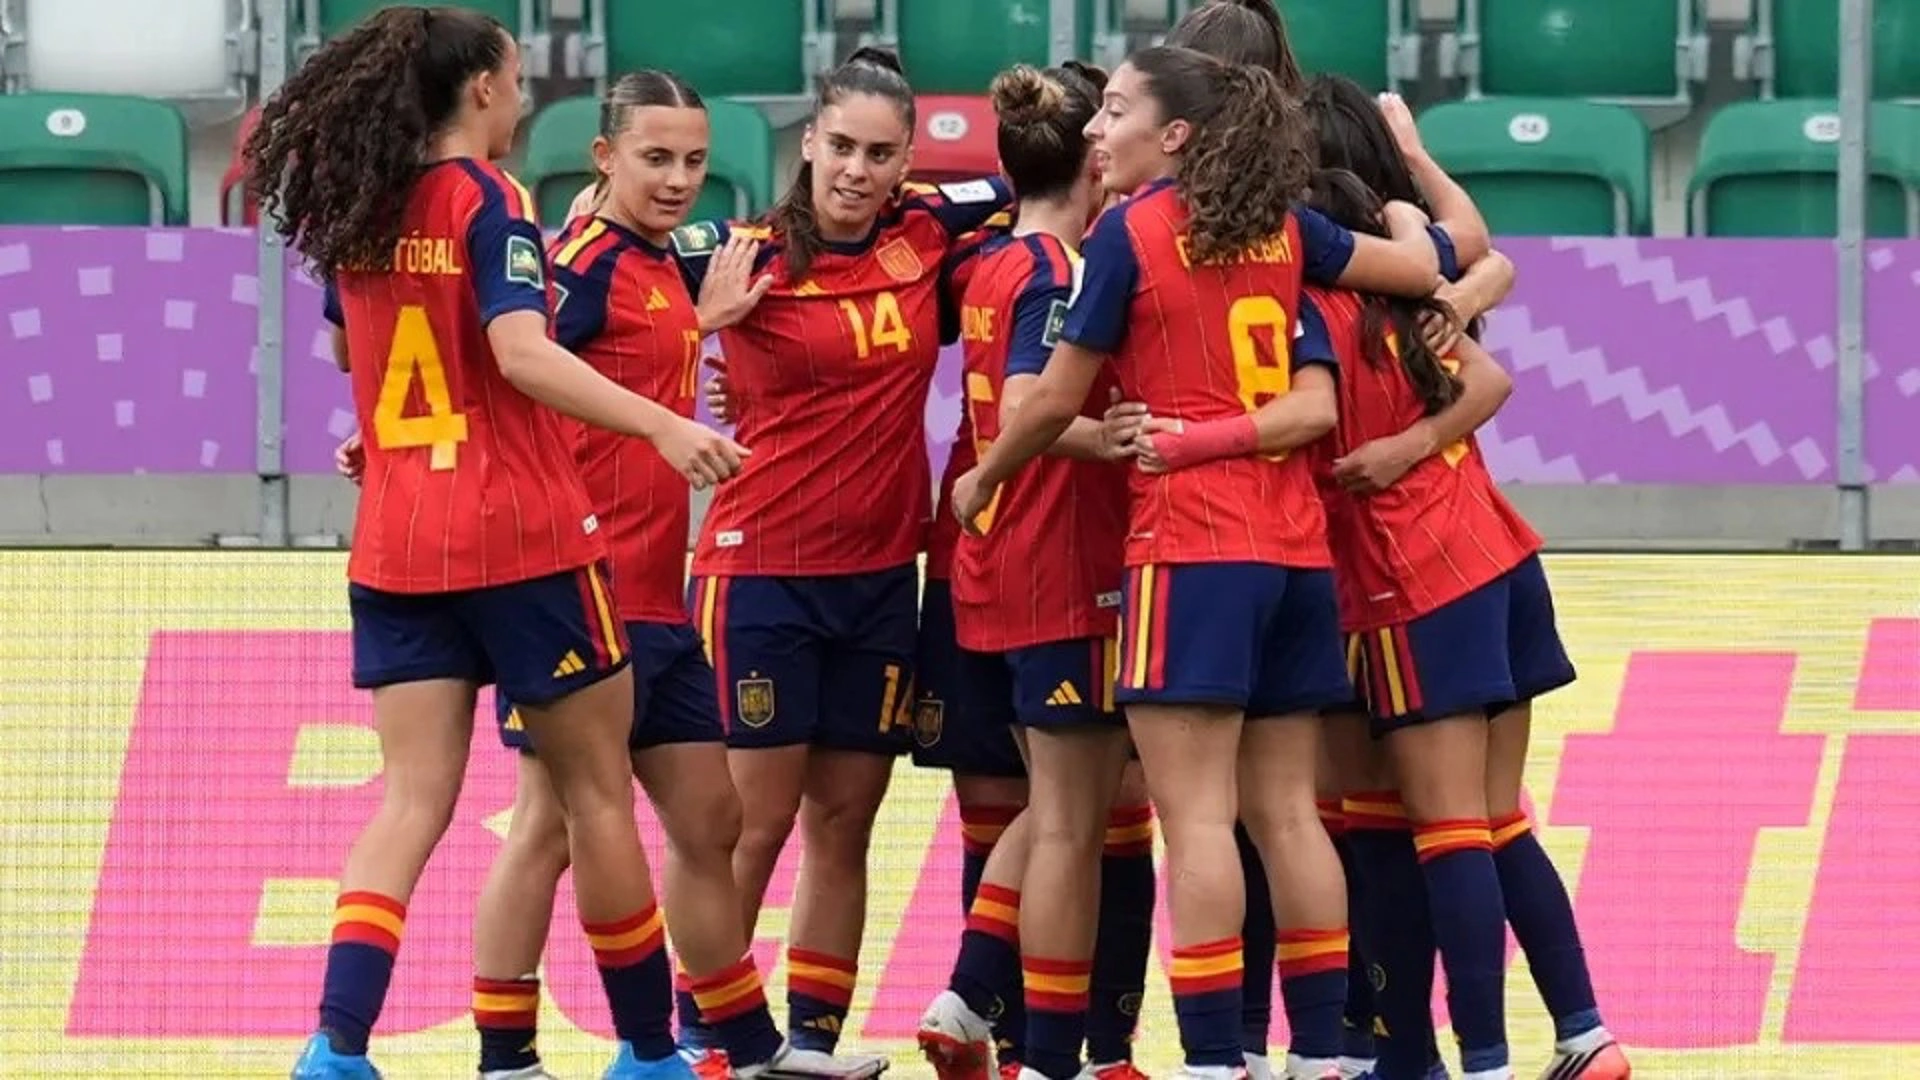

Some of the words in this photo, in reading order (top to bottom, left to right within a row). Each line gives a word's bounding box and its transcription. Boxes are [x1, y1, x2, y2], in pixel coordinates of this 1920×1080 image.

[373, 305, 469, 472] 4
[838, 291, 911, 358] 14
[1228, 295, 1290, 462] 8
